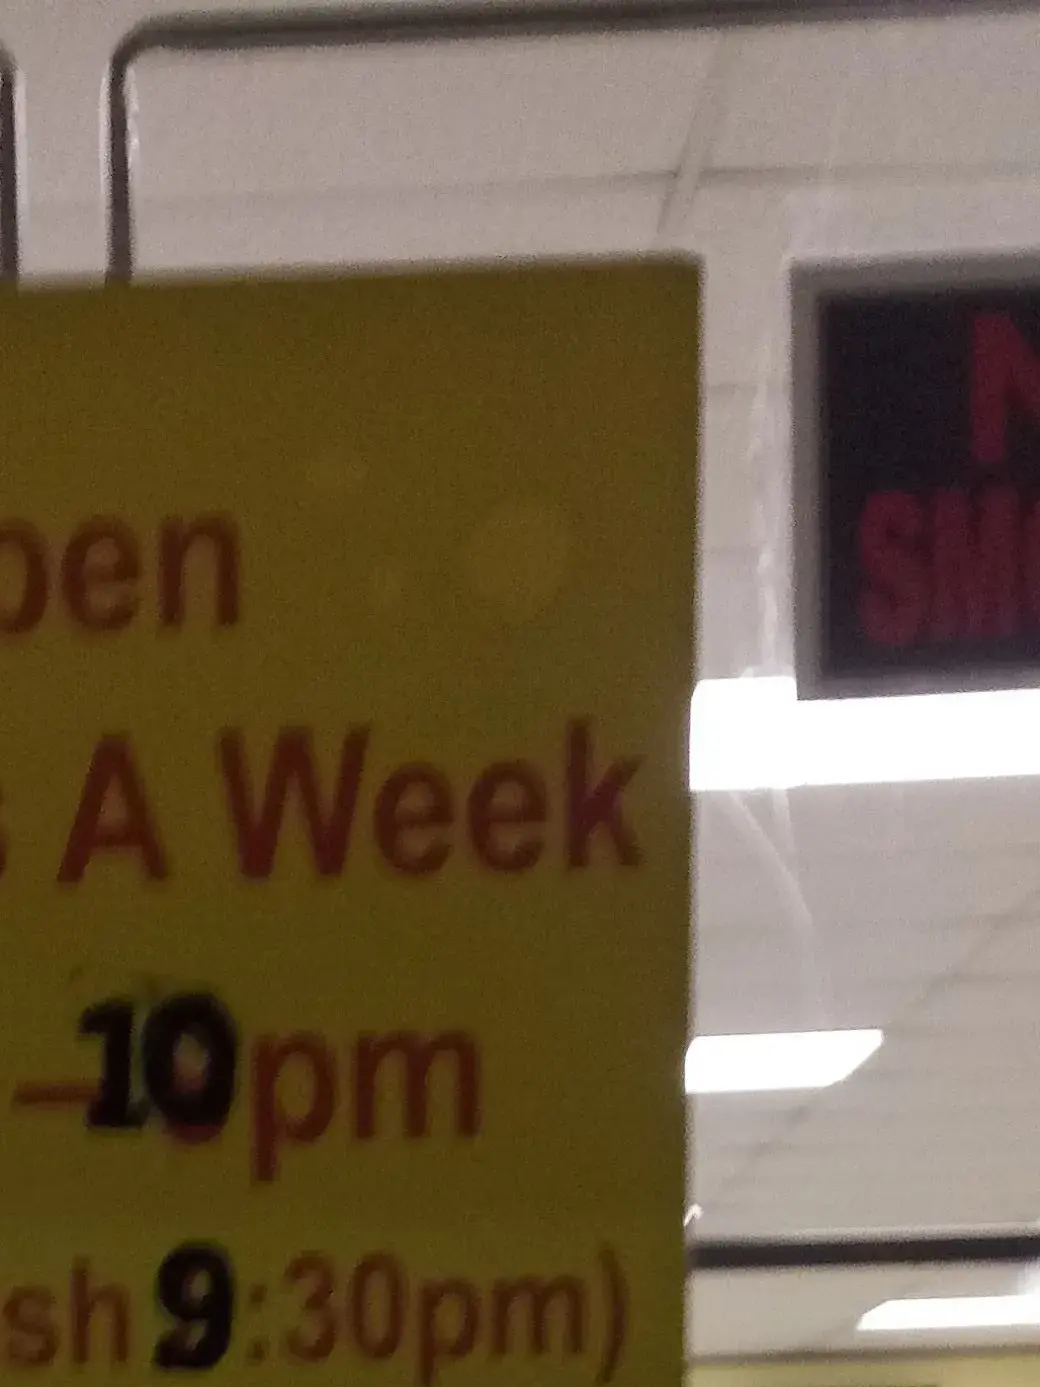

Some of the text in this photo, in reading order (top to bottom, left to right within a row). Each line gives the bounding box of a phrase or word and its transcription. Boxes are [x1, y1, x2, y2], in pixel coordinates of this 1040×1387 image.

[56, 730, 170, 886] A
[219, 715, 647, 882] Week
[151, 1240, 630, 1387] 9:30pm)
